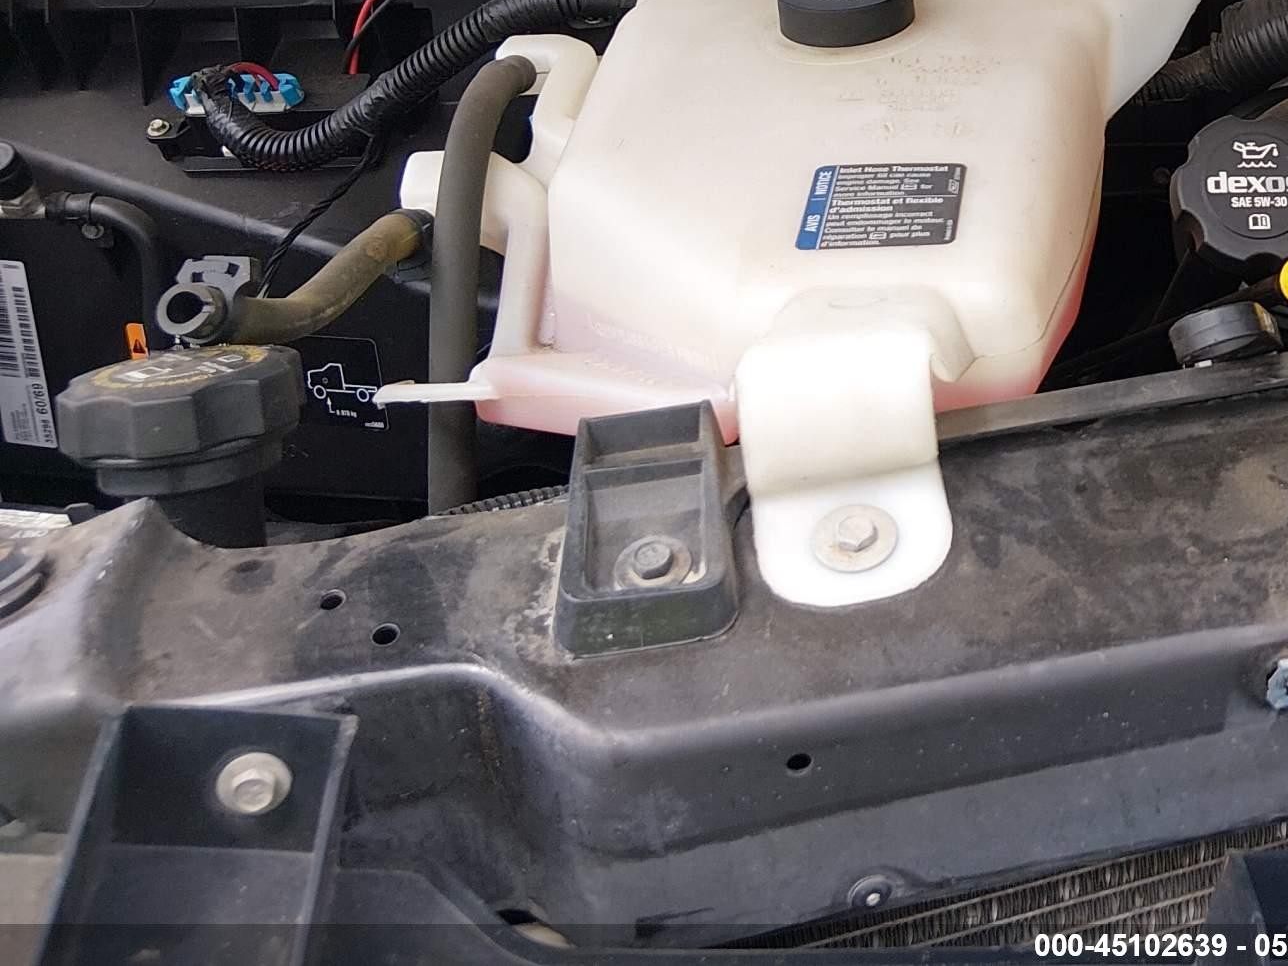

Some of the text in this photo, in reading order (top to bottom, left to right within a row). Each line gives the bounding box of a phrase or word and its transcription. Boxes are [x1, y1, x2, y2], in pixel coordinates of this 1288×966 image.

[814, 170, 832, 195] NOTICE
[832, 198, 890, 206] Thermostat
[1231, 196, 1288, 208] SAE 5W-30
[804, 214, 820, 232] AVIS
[31, 383, 48, 415] 60/69
